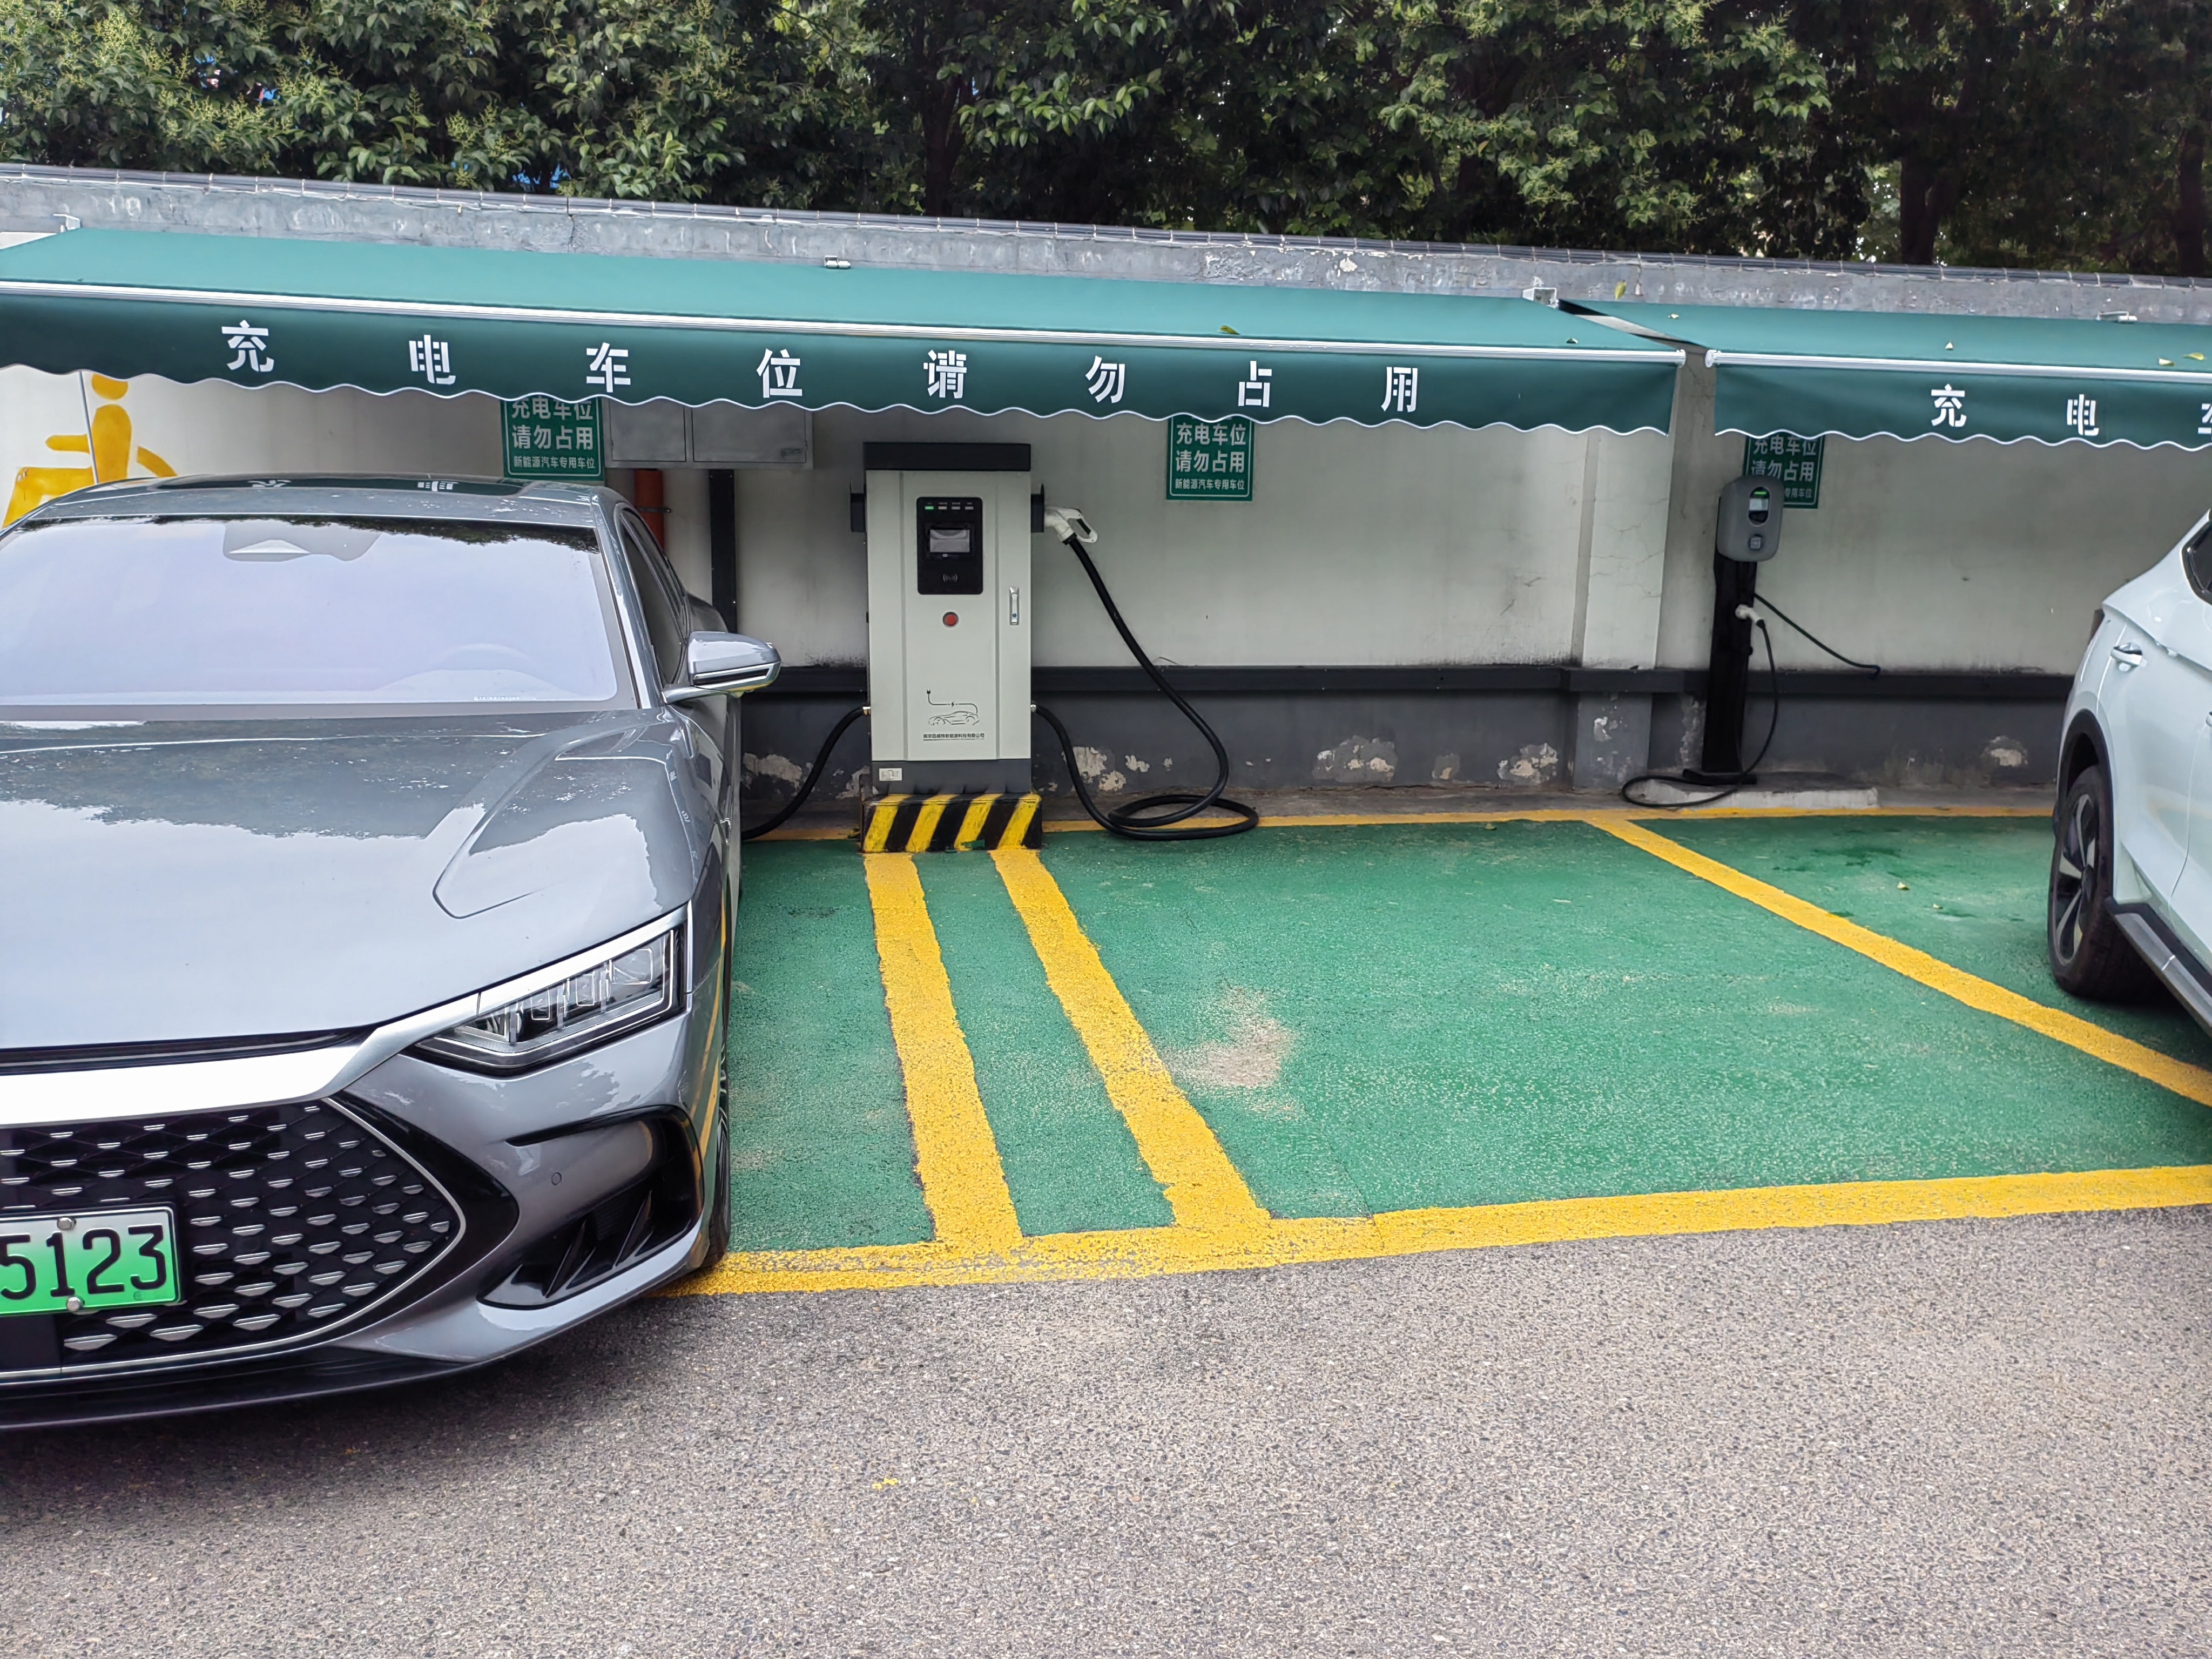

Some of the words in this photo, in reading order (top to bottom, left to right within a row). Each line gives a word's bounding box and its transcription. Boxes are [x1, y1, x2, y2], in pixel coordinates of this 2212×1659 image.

[221, 320, 1418, 412] 充电车位请勿占用
[511, 396, 594, 420] 充电车位
[512, 425, 594, 450] 请勿占用
[1176, 423, 1246, 446] 充电车位
[1753, 434, 1816, 456] 充电车位
[514, 456, 595, 469] 新能源汽车专用车位
[1175, 450, 1245, 473] 请勿占用
[1751, 460, 1814, 481] 请勿占用
[1175, 478, 1245, 490] 新能源汽车专用车位
[0, 1223, 167, 1300] 5123
